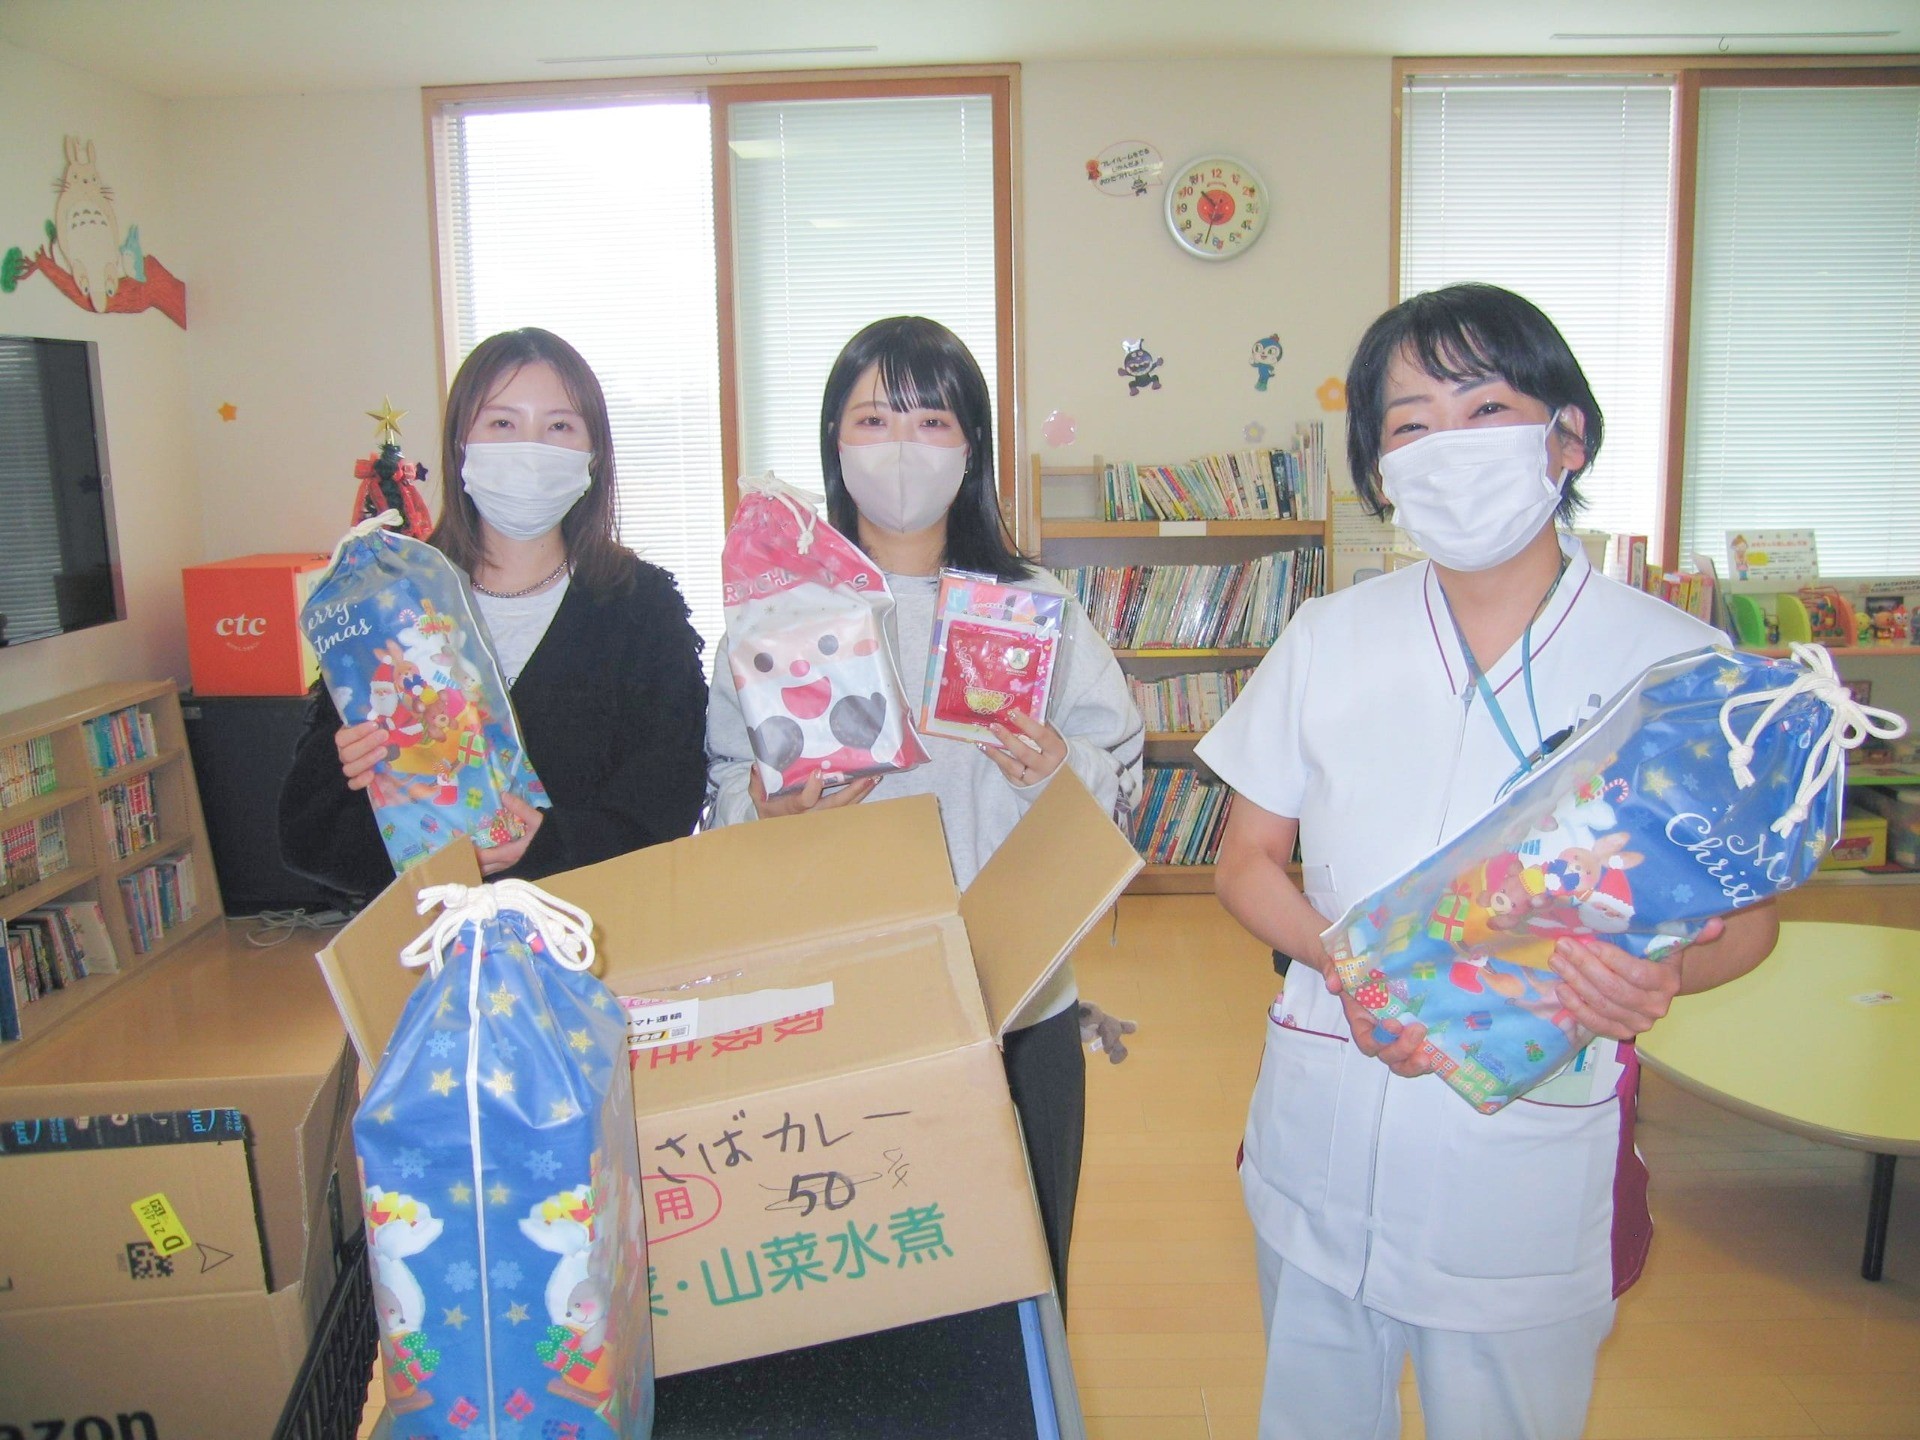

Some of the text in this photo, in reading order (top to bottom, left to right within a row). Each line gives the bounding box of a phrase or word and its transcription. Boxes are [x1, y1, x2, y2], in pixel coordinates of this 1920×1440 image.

[1211, 168, 1222, 179] 12
[1183, 186, 1194, 197] 10
[1181, 203, 1188, 213] 9
[1246, 203, 1253, 213] 3
[1185, 219, 1192, 229] 8
[1241, 220, 1248, 230] 4
[1212, 237, 1219, 247] 6
[1229, 232, 1236, 242] 5
[307, 601, 350, 632] erry
[215, 612, 268, 637] ctc
[628, 1011, 683, 1027] マト運輸
[654, 1109, 912, 1184] さばカレー
[788, 1170, 857, 1218] 50
[654, 1185, 695, 1227] 用
[162, 1235, 185, 1252] D
[648, 1202, 955, 1317] ・山菜水煮
